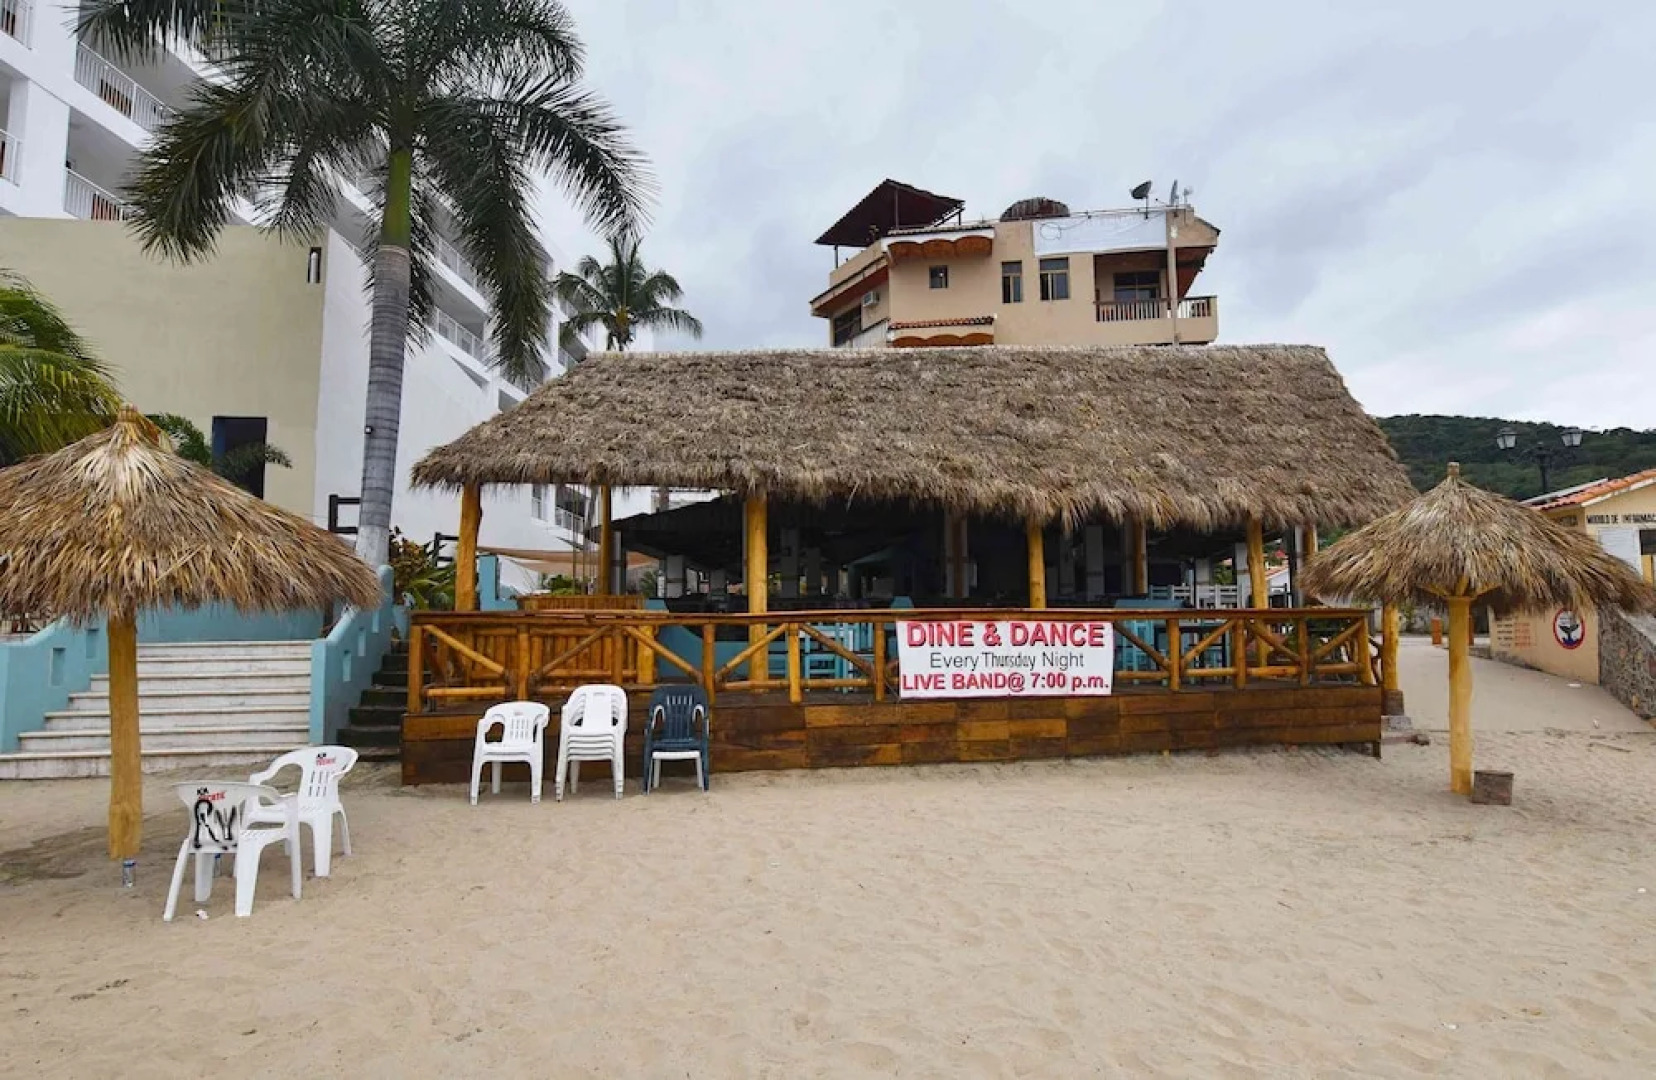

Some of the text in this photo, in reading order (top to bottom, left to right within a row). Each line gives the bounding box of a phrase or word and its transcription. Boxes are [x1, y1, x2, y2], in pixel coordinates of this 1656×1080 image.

[906, 622, 1105, 648] DINE & DANCE
[930, 651, 1084, 671] Every Thursday Night
[902, 673, 946, 691] LIVE
[1030, 672, 1066, 689] 7:00
[1071, 674, 1109, 691] p.m.
